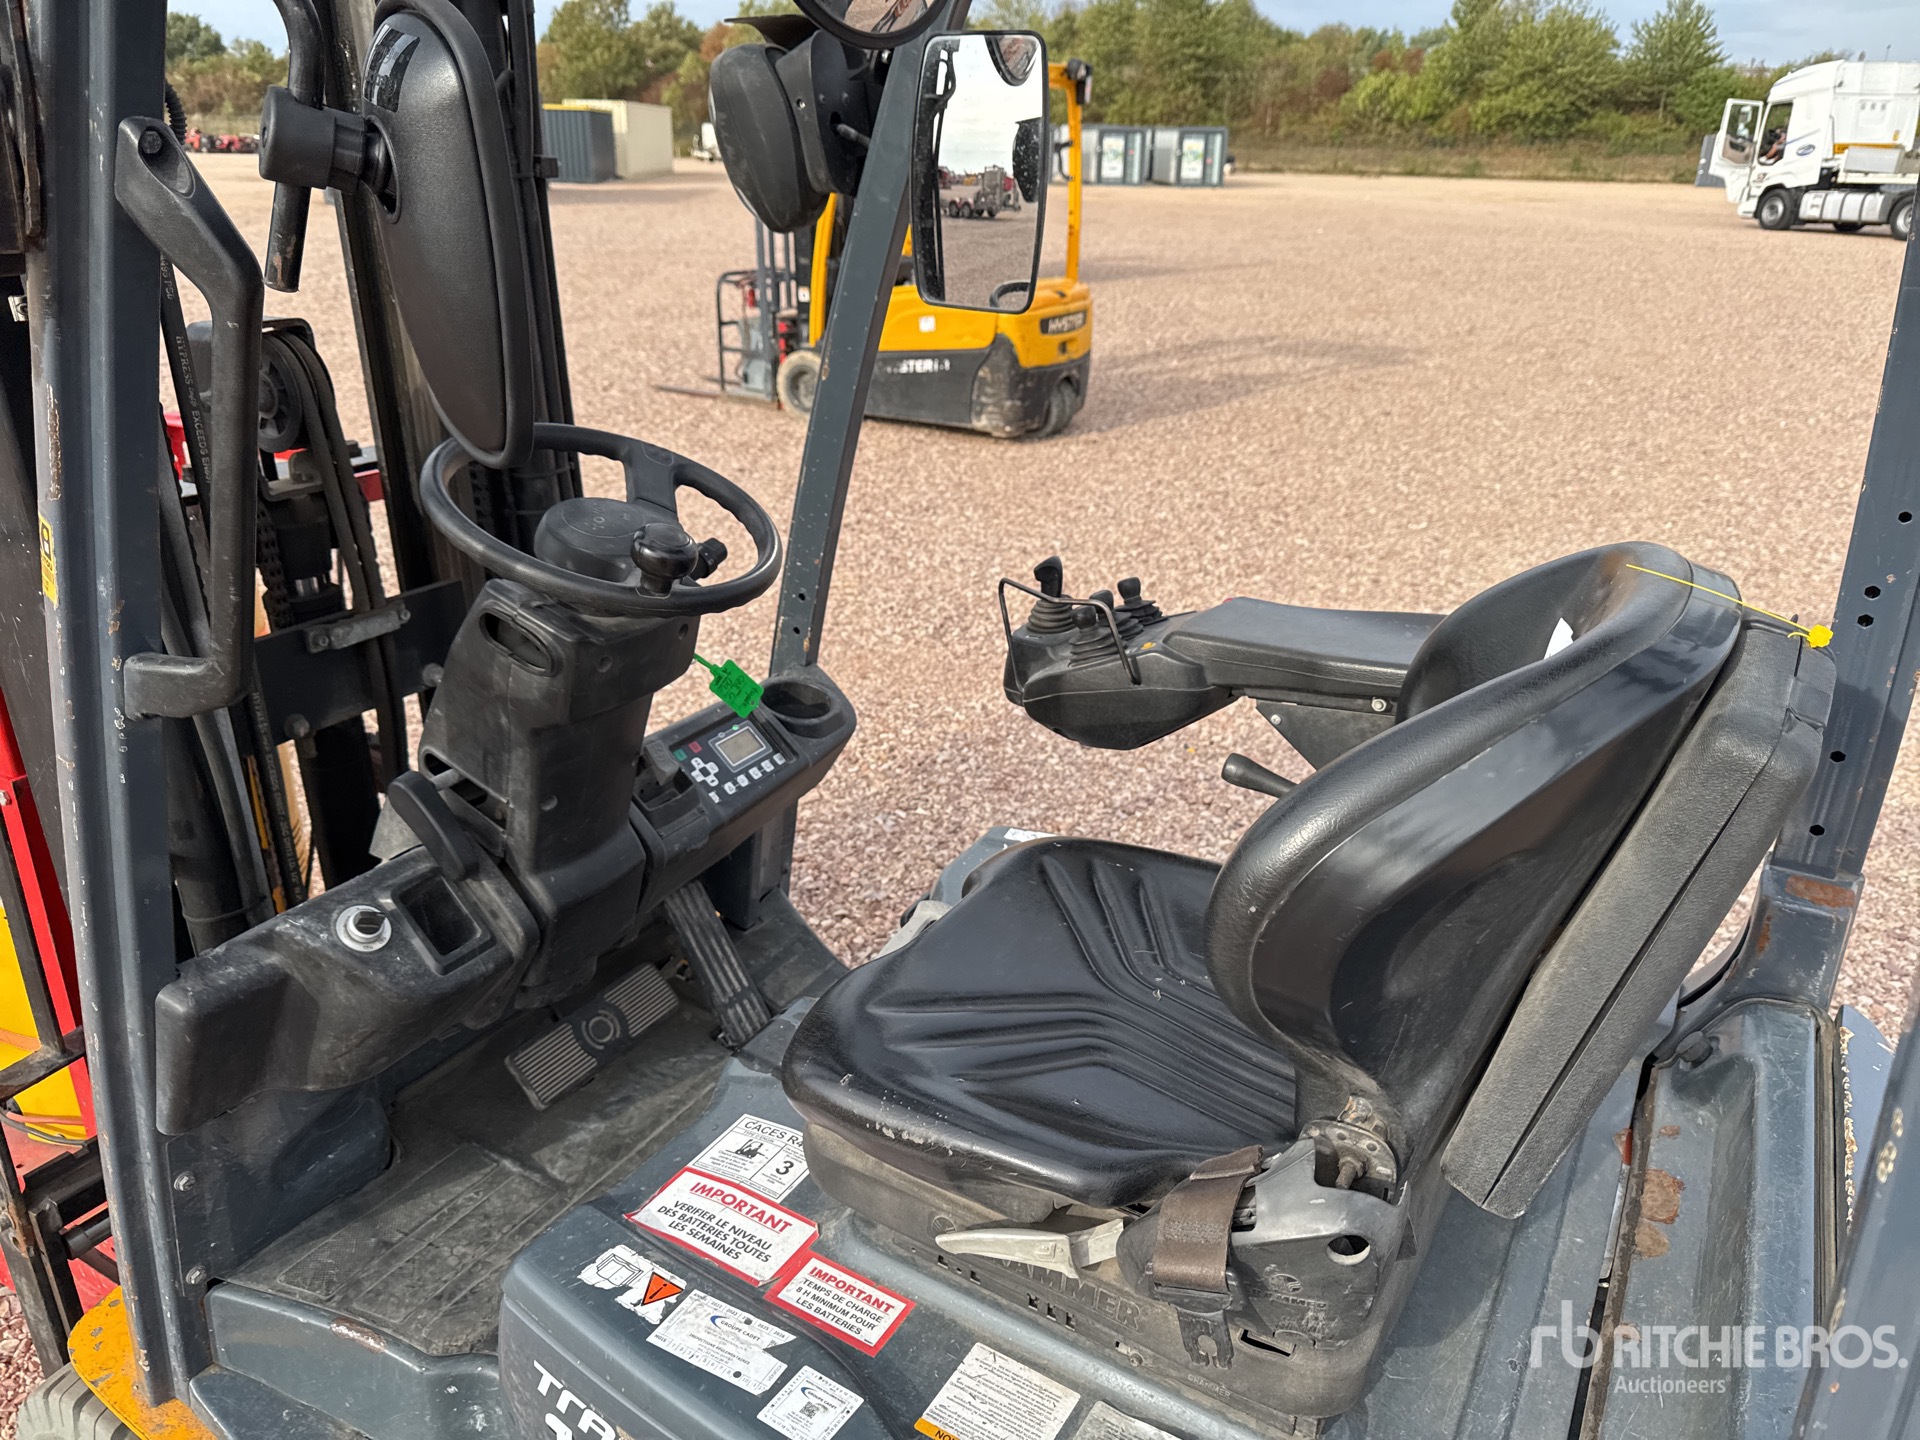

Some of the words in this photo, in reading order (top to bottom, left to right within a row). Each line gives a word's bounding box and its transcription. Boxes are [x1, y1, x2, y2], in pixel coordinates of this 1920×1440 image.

[190, 409, 209, 455] EXCEEDS
[744, 1121, 788, 1139] CACES
[775, 1160, 794, 1175] 3
[674, 1200, 717, 1223] VERIFIER
[716, 1217, 730, 1229] LE
[728, 1224, 773, 1251] NIVEAU
[690, 1181, 793, 1233] IMPORTANT
[657, 1205, 677, 1218] DES
[677, 1213, 732, 1241] BATTERIES
[731, 1235, 772, 1263] TOUTES
[668, 1220, 686, 1232] LES
[686, 1228, 742, 1260] SEMAINES
[802, 1278, 833, 1298] TEMPS
[831, 1293, 846, 1304] DE
[845, 1300, 884, 1324] CHARGE
[802, 1289, 811, 1298] H
[810, 1293, 850, 1317] MINIMUM
[850, 1313, 878, 1332] POUR
[809, 1266, 895, 1314] IMPORTANT
[653, 1332, 667, 1343] MOIS
[720, 1319, 742, 1333] GROUPE
[741, 1329, 760, 1342] CADET
[795, 1297, 813, 1311] LES
[813, 1307, 863, 1336] BATTERIES
